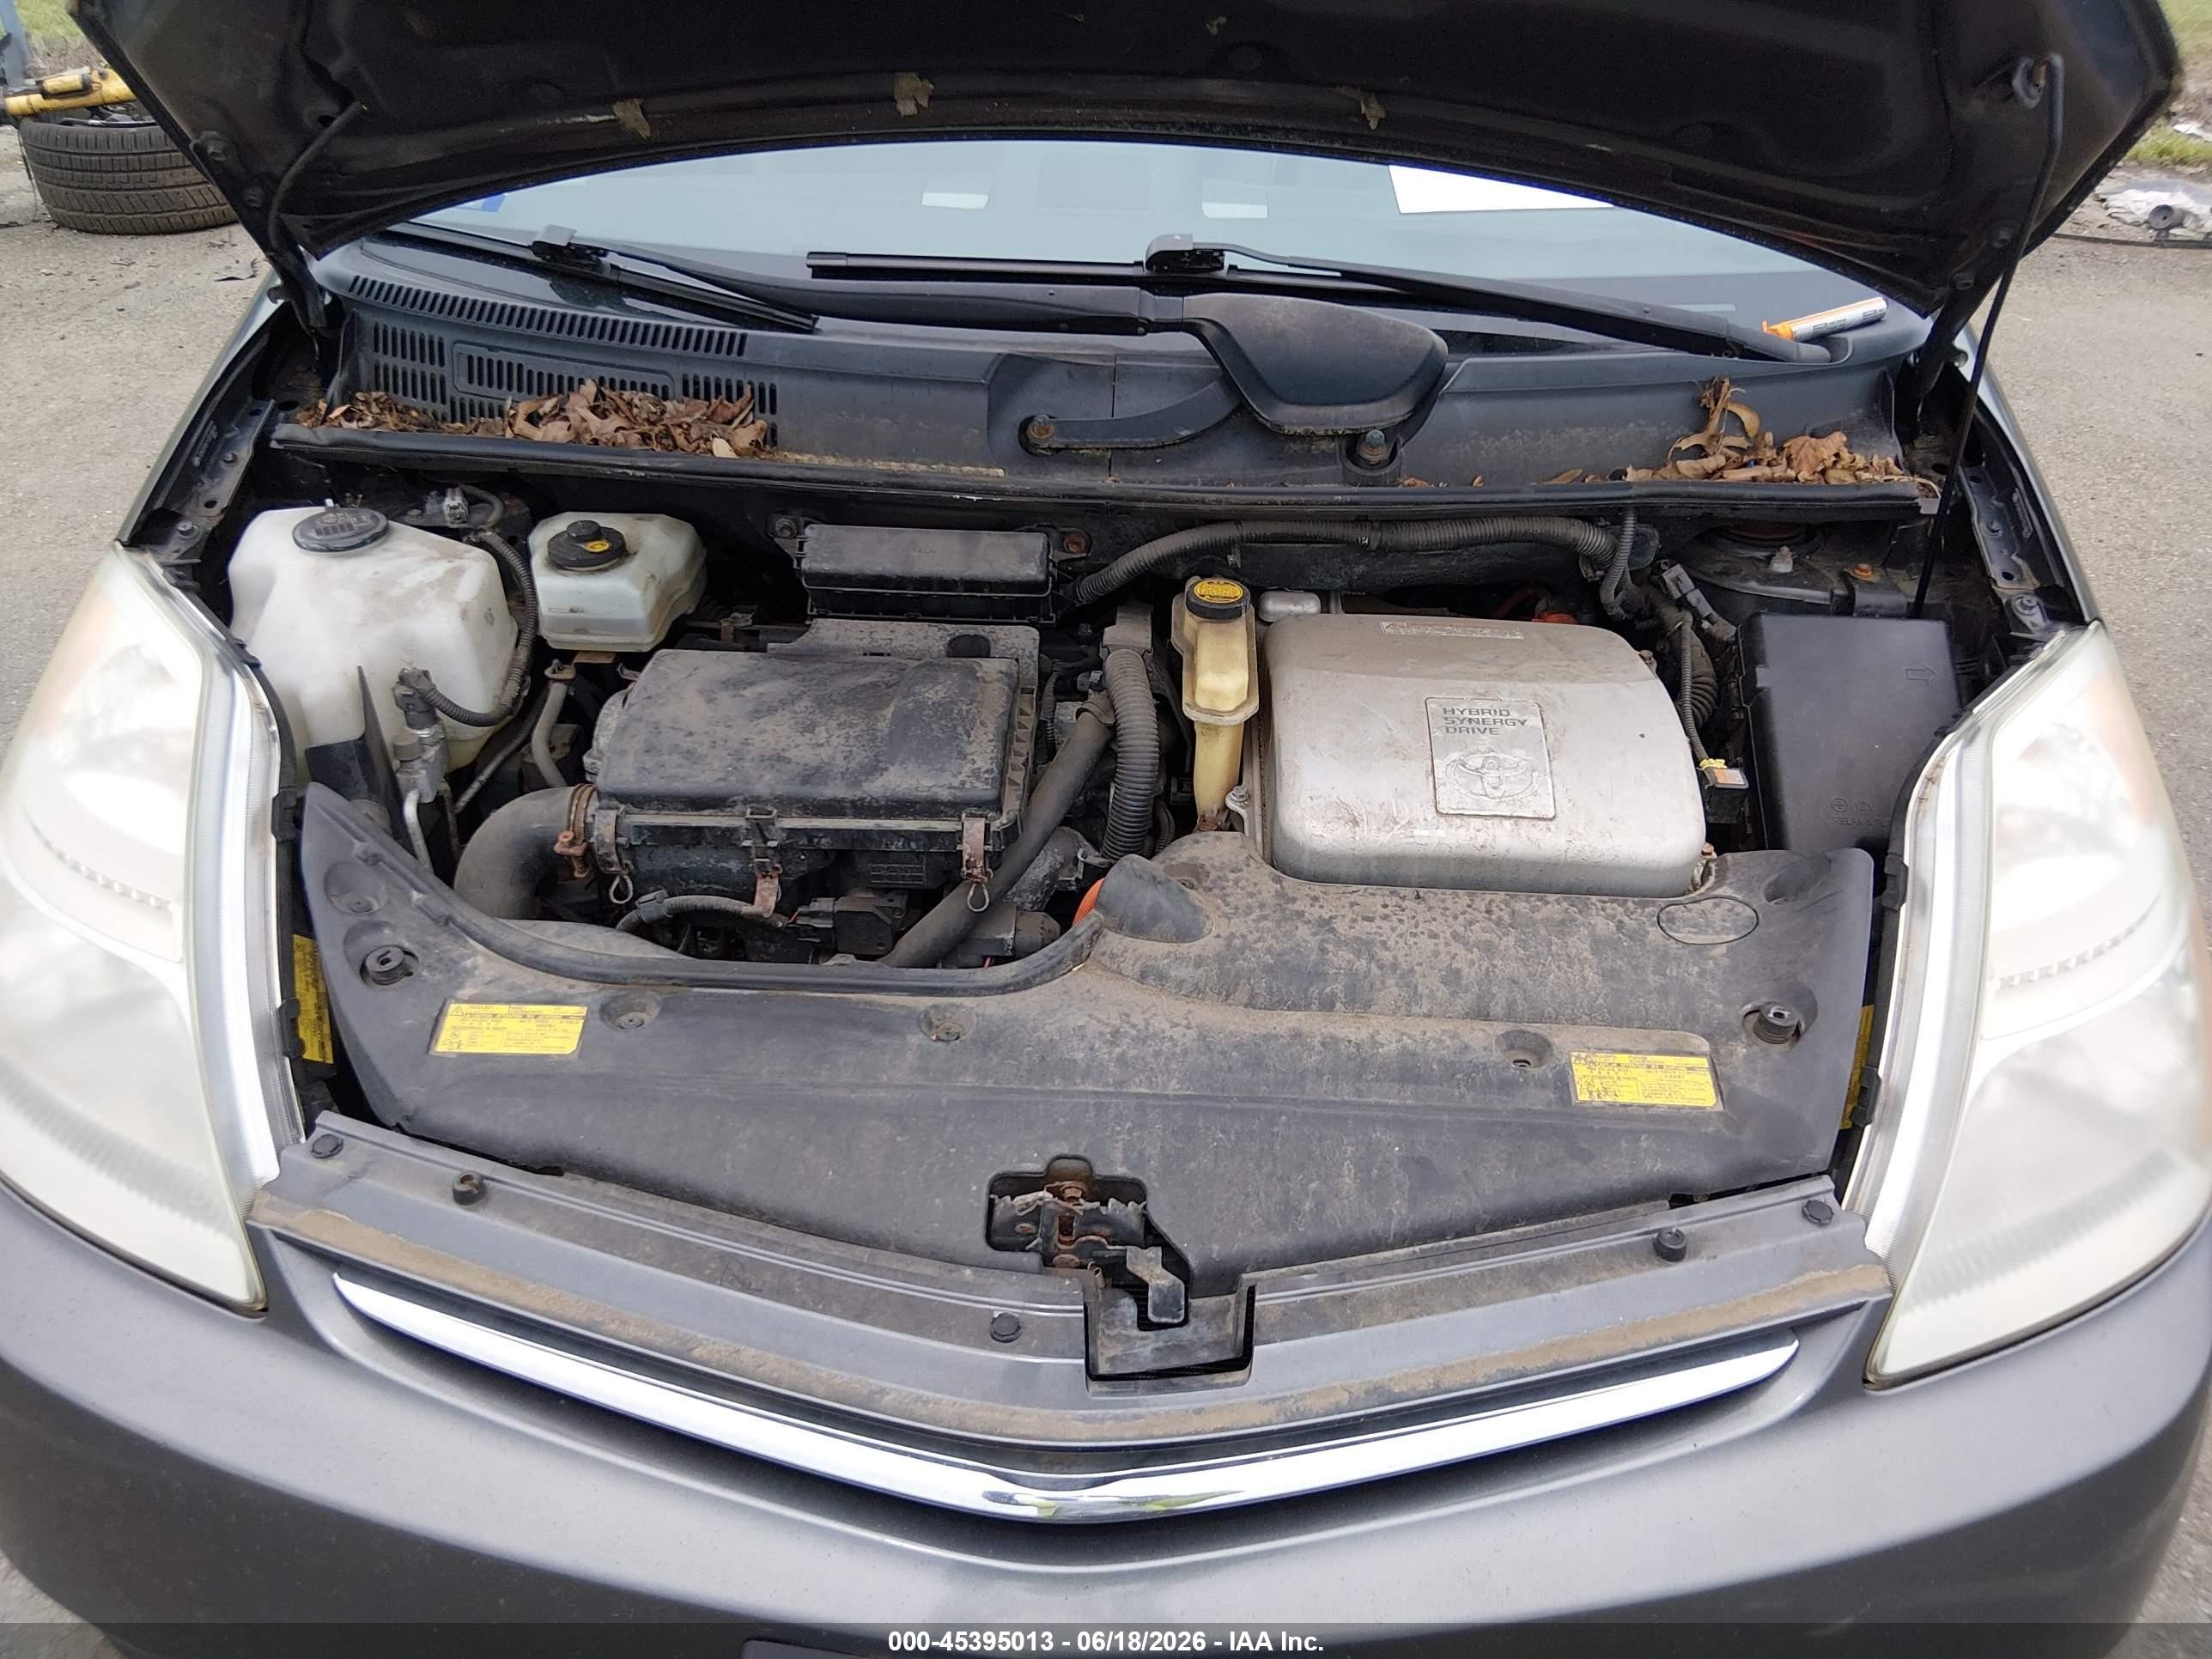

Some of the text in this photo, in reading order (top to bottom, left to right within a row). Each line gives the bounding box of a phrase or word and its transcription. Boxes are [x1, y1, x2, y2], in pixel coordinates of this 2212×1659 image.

[1443, 708, 1510, 717] HYBRID
[1444, 717, 1528, 726] SYNERGY
[1445, 726, 1500, 736] DRIVE
[1833, 817, 1863, 826] RELAY
